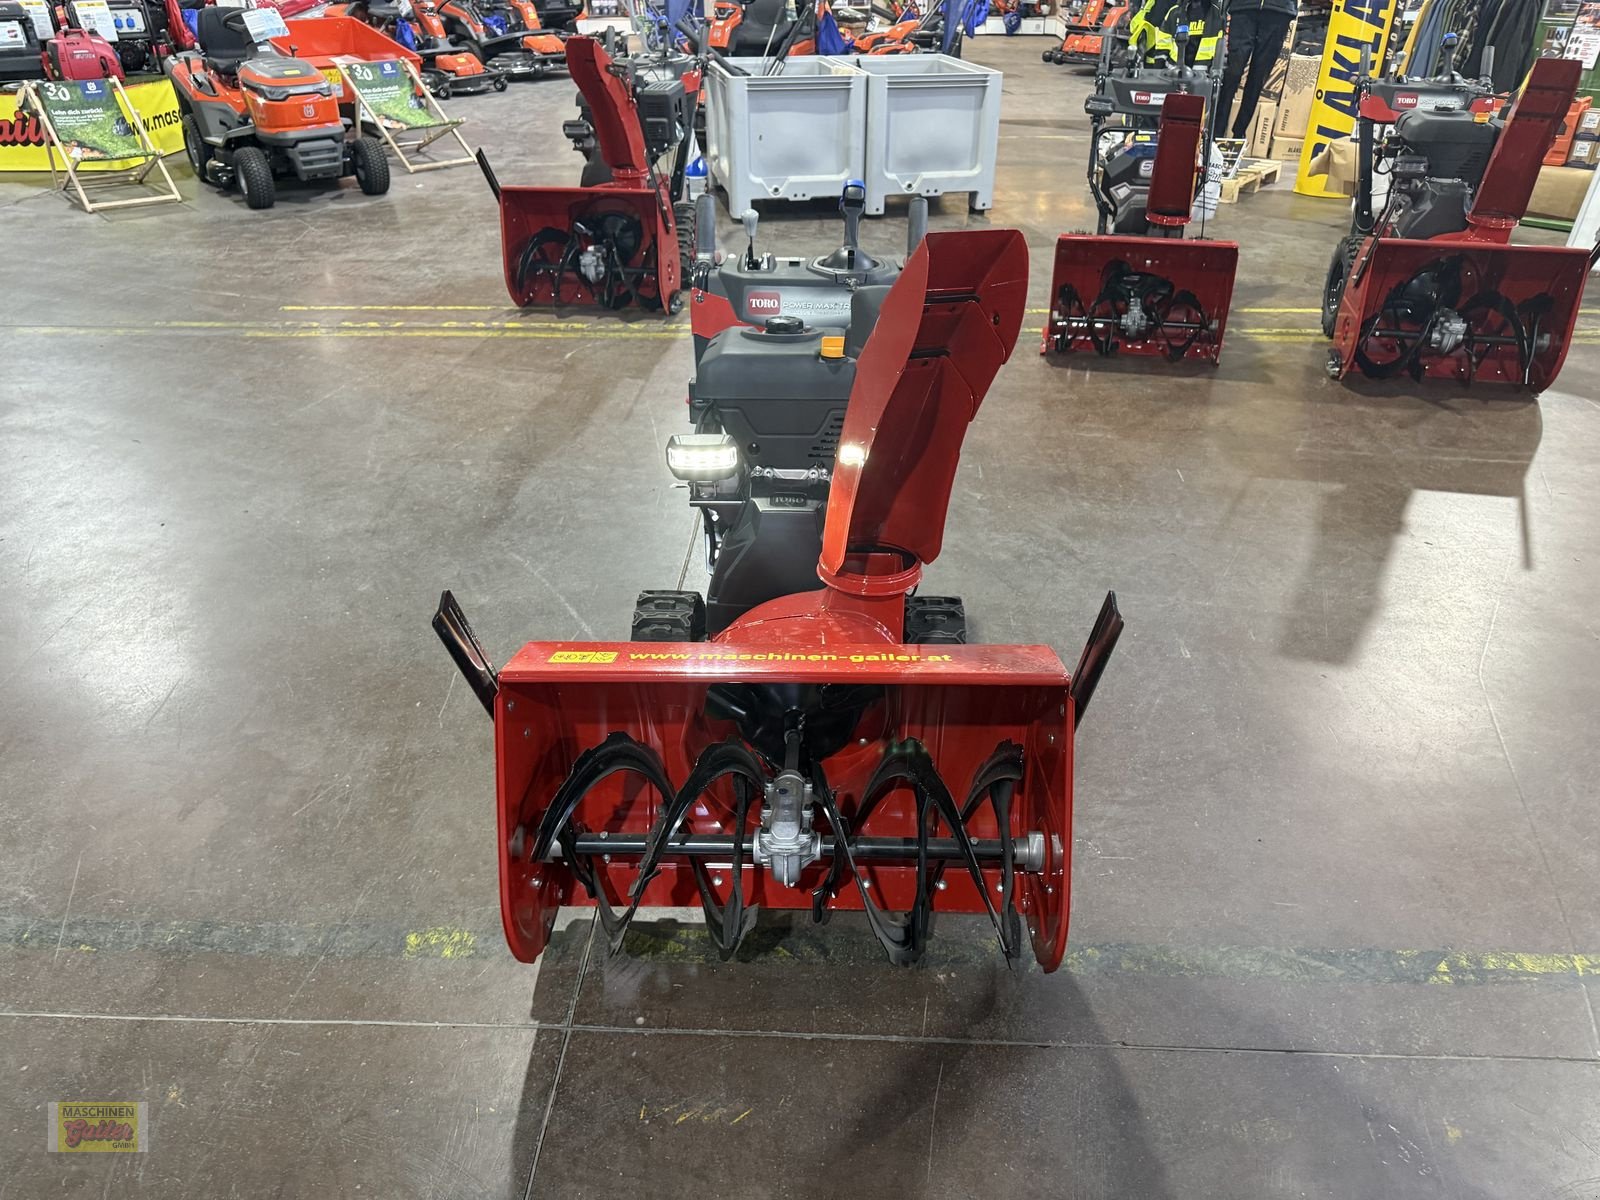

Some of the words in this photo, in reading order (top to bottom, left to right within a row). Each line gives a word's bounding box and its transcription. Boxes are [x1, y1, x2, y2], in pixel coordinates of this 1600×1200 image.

[749, 298, 779, 309] TORO
[783, 302, 814, 310] POWER
[629, 652, 953, 663] www.maschinen-gailer.at
